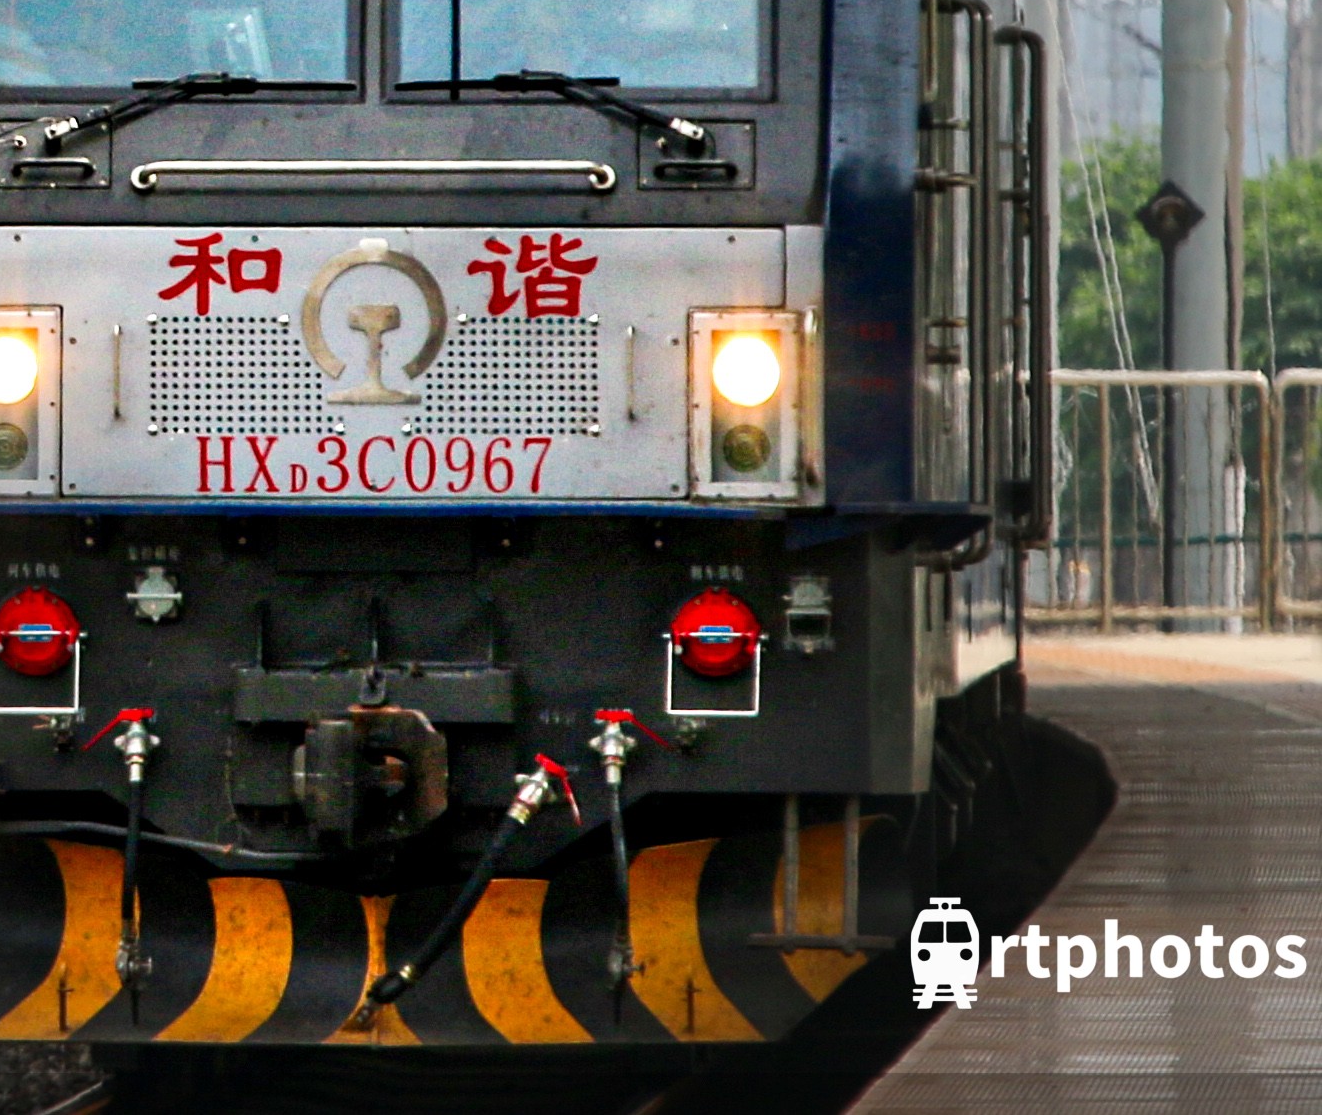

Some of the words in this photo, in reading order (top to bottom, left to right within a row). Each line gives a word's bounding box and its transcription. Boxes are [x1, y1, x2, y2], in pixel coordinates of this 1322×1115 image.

[158, 232, 283, 317] 和
[466, 232, 598, 319] 谐
[196, 435, 553, 494] HXD3C0967
